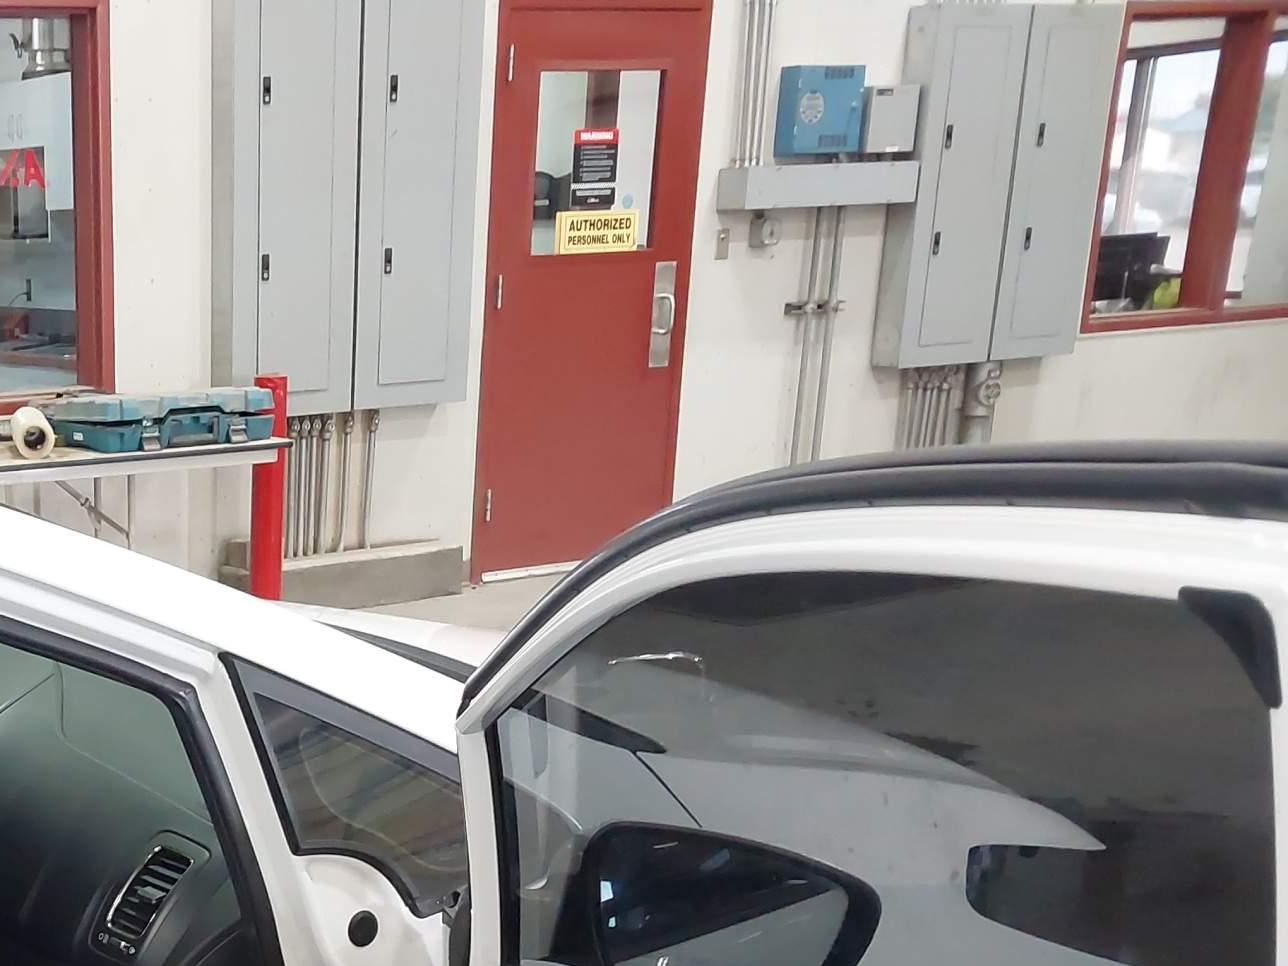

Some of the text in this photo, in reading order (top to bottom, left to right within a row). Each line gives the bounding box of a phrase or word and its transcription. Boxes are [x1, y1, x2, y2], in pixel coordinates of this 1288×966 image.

[569, 217, 631, 232] AUTHORIZED
[568, 233, 631, 246] PERSONNEL ONLY
